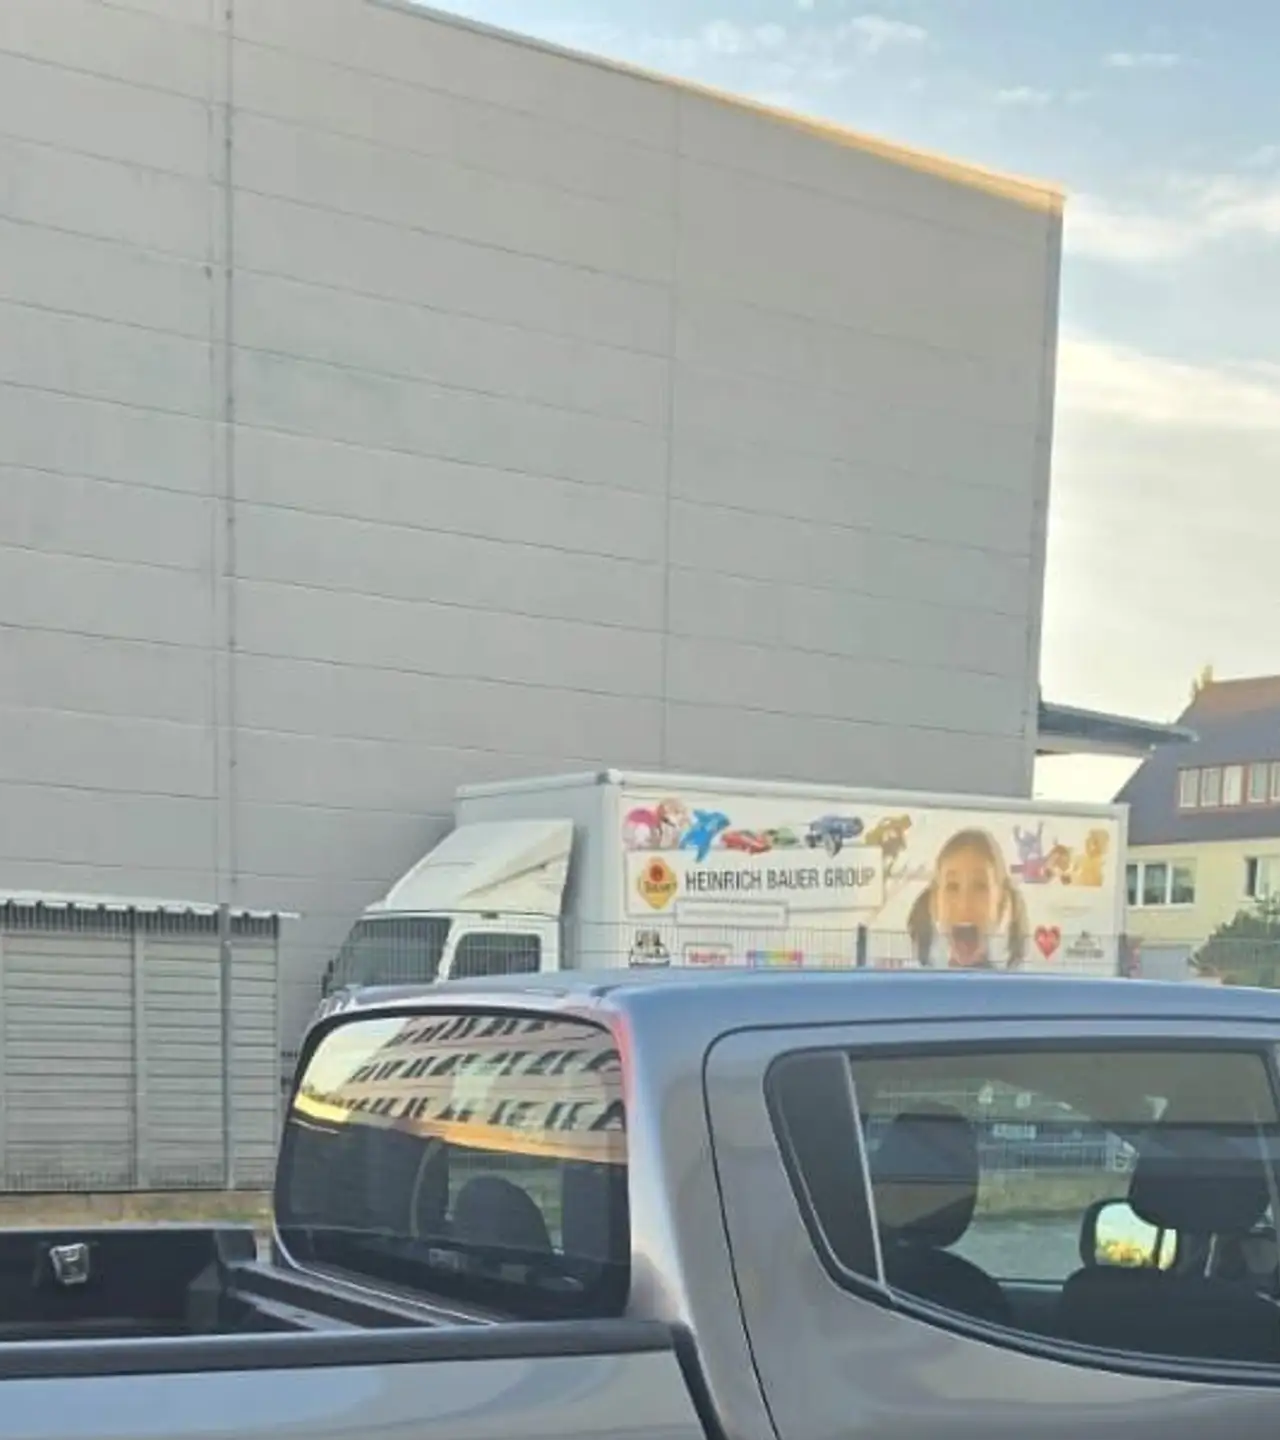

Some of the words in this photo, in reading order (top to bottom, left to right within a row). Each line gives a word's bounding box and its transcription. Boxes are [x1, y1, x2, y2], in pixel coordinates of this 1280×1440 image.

[685, 869, 761, 892] HEINRICH
[767, 868, 820, 889] BAUER
[824, 866, 876, 887] GROUP
